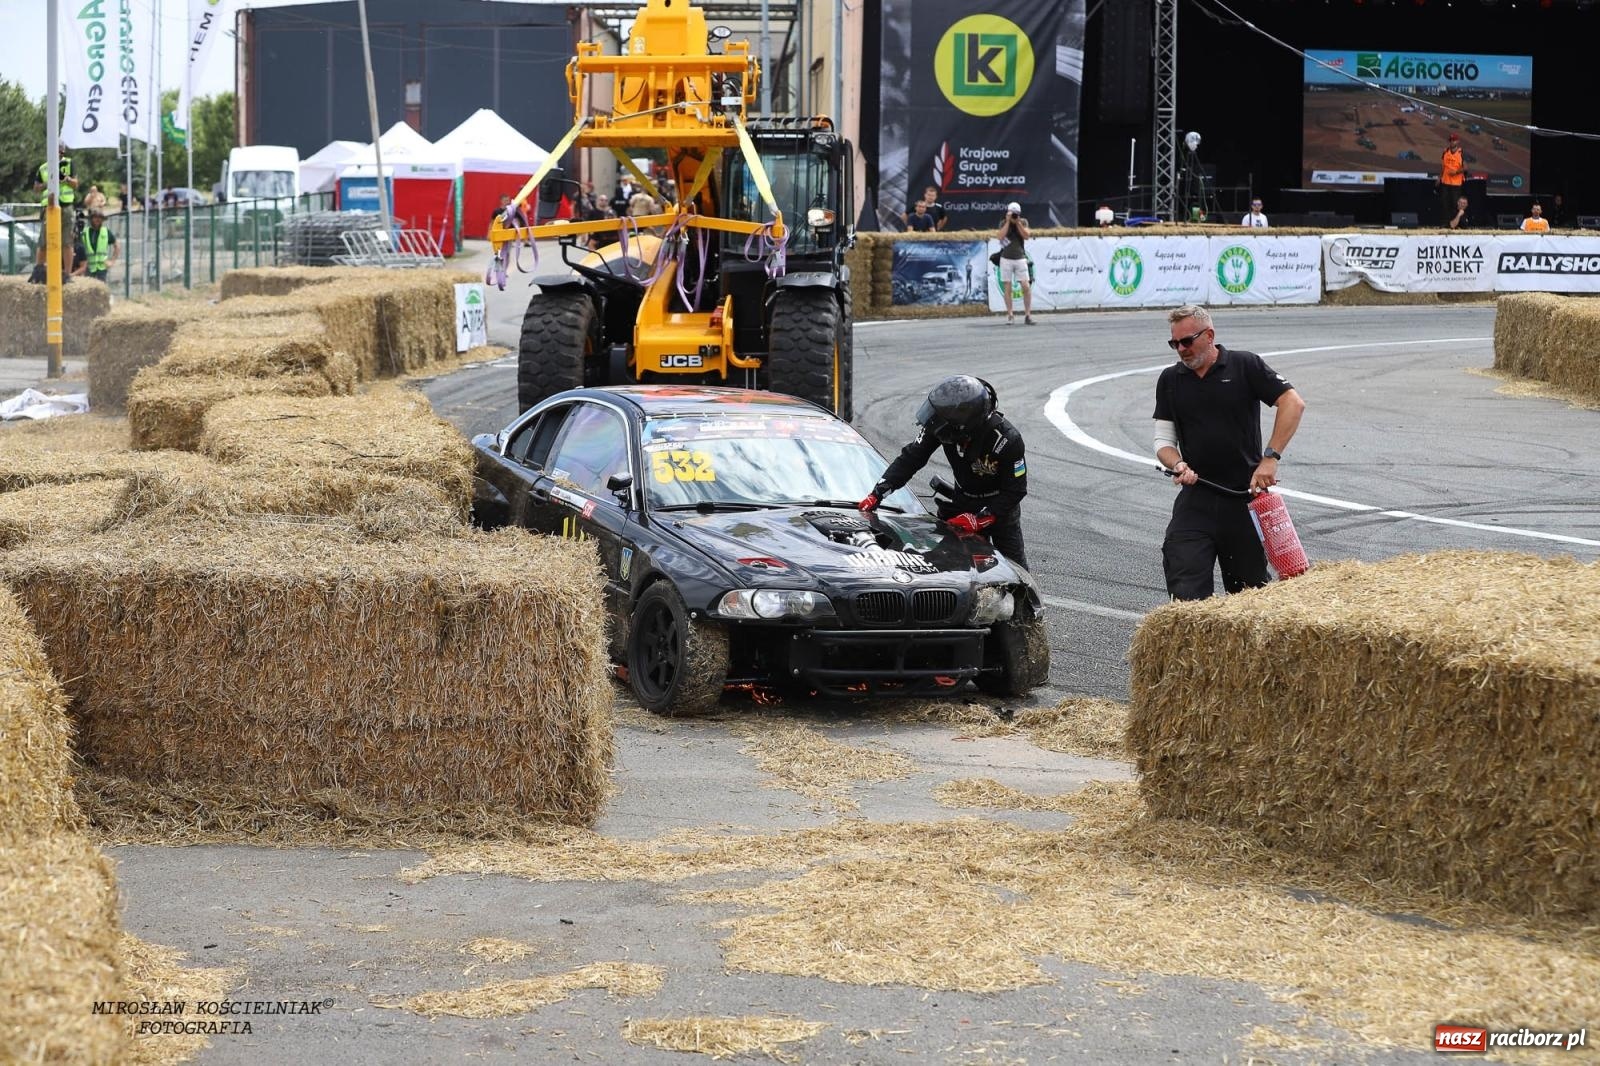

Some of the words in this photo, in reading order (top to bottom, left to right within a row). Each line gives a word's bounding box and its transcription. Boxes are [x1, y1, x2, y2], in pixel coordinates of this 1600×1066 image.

[1384, 56, 1479, 81] AGROEKO
[960, 148, 1010, 161] Krajowa
[959, 161, 998, 174] Grupa
[958, 174, 1026, 187] Spożywcza
[943, 201, 969, 212] Grupa
[1346, 246, 1400, 258] MOTO
[1417, 245, 1484, 259] MIKINKA
[1417, 261, 1485, 274] PROJEKT
[660, 355, 703, 367] JCB
[652, 450, 716, 484] 532
[902, 565, 939, 574] TEAM
